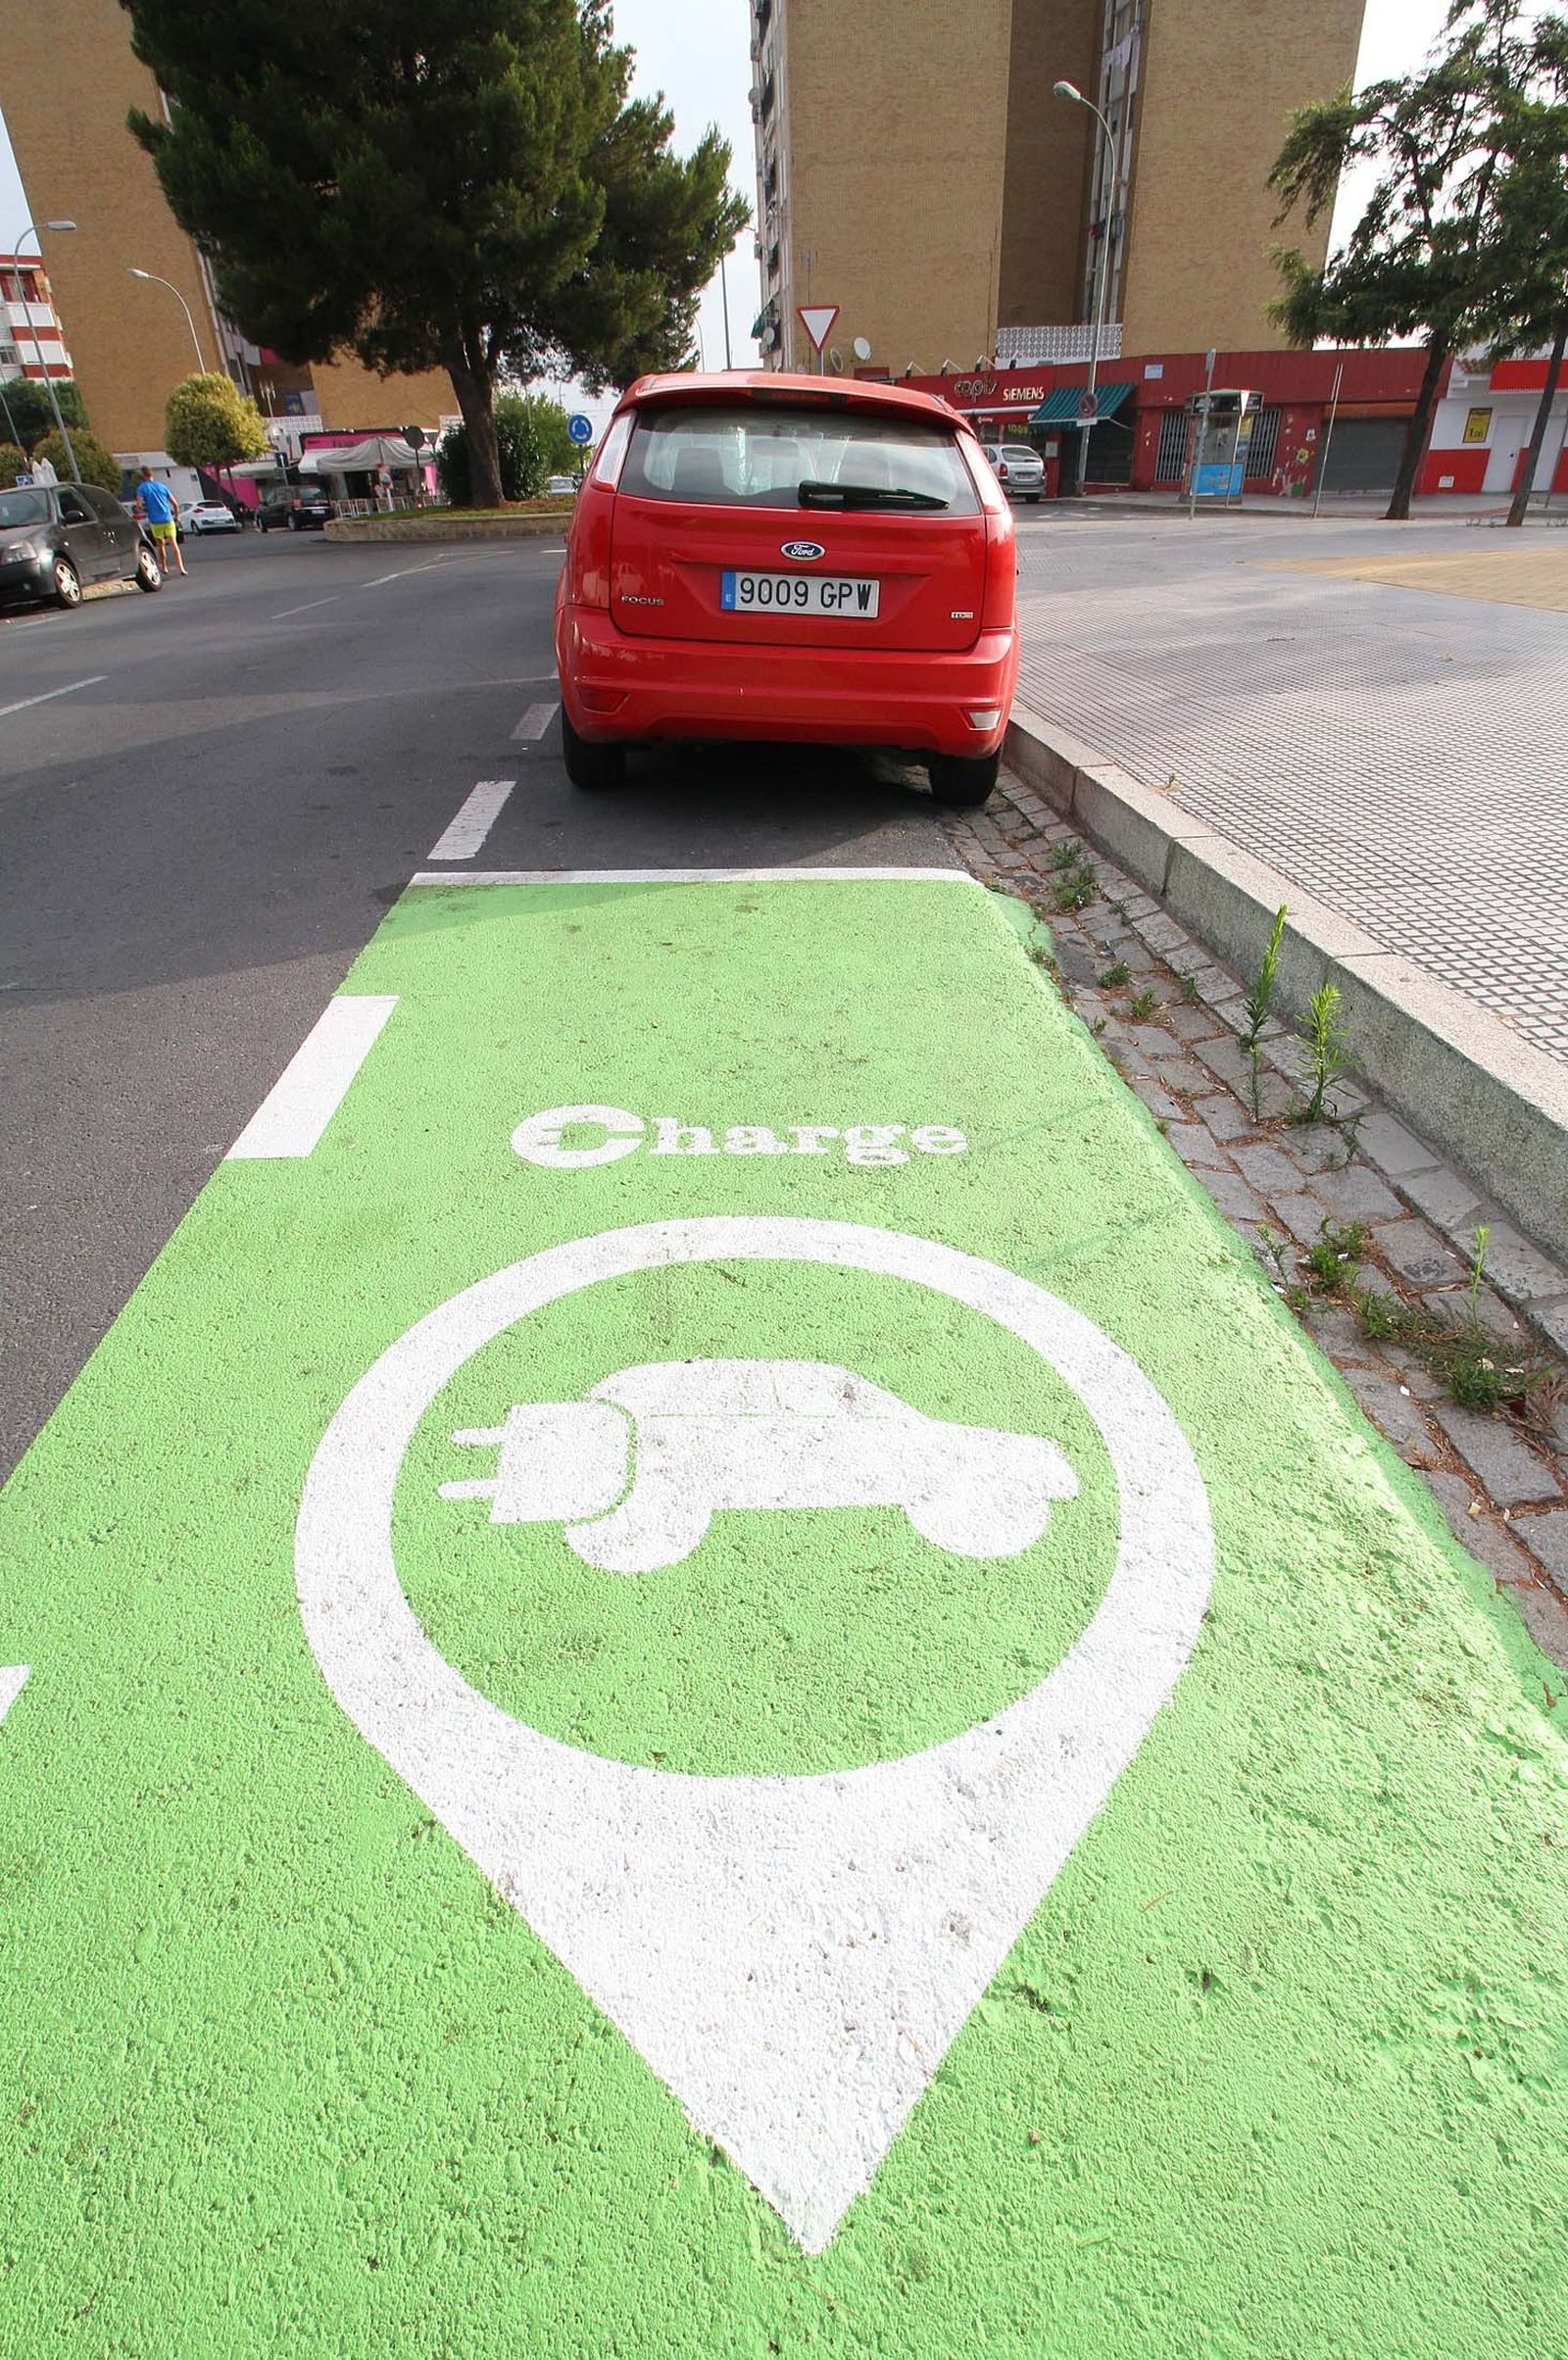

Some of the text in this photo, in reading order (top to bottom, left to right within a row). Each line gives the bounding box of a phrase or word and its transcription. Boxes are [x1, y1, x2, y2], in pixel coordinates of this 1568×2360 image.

[1003, 386, 1045, 402] SIEMENS
[791, 544, 815, 557] Ford
[621, 595, 664, 606] FOCUS
[725, 594, 732, 603] E
[740, 577, 872, 612] 9009 GPW
[509, 1104, 968, 1168] Charge
